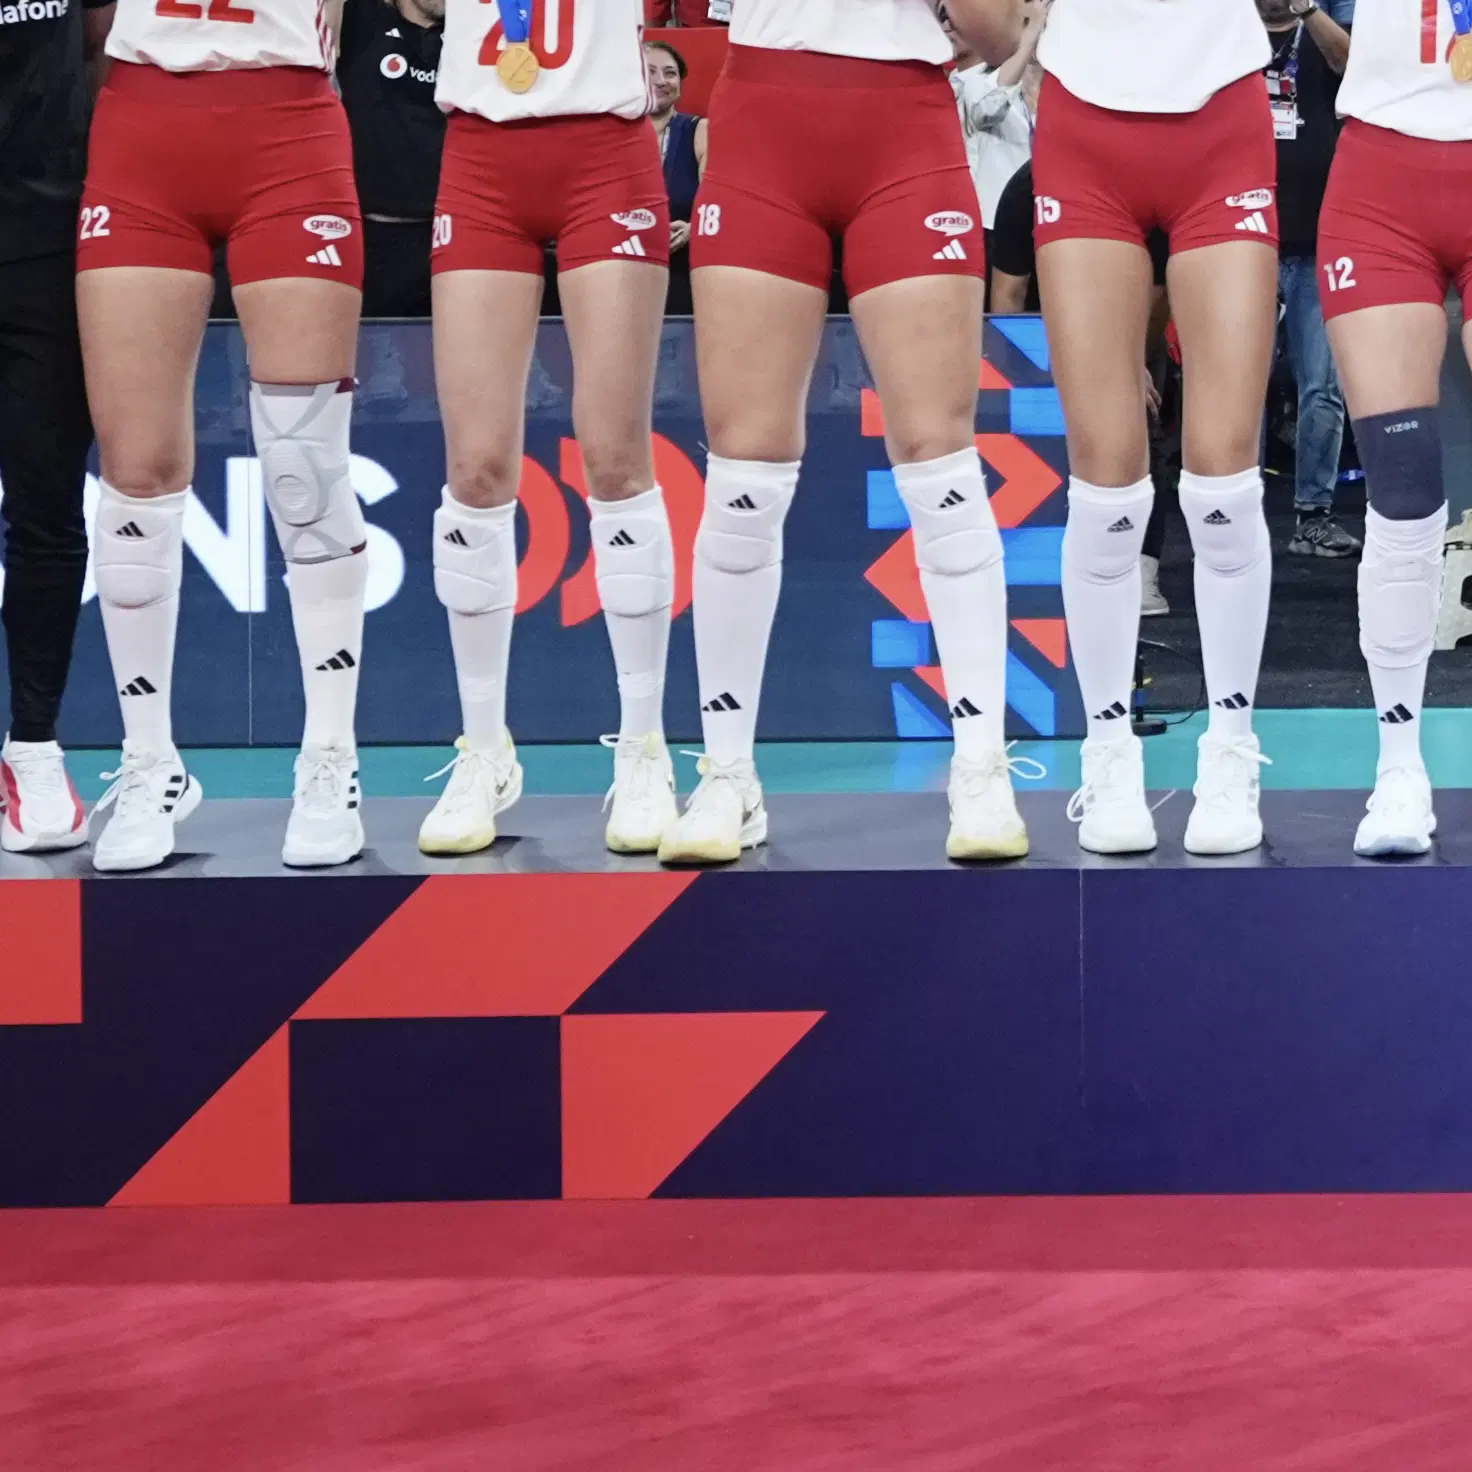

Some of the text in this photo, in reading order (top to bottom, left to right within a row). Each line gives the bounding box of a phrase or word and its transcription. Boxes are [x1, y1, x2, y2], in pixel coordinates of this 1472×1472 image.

[80, 205, 110, 240] 22
[697, 203, 721, 236] 18
[932, 215, 969, 227] gratis
[1034, 195, 1060, 224] 15
[310, 219, 347, 232] gratis
[1323, 256, 1356, 292] 12
